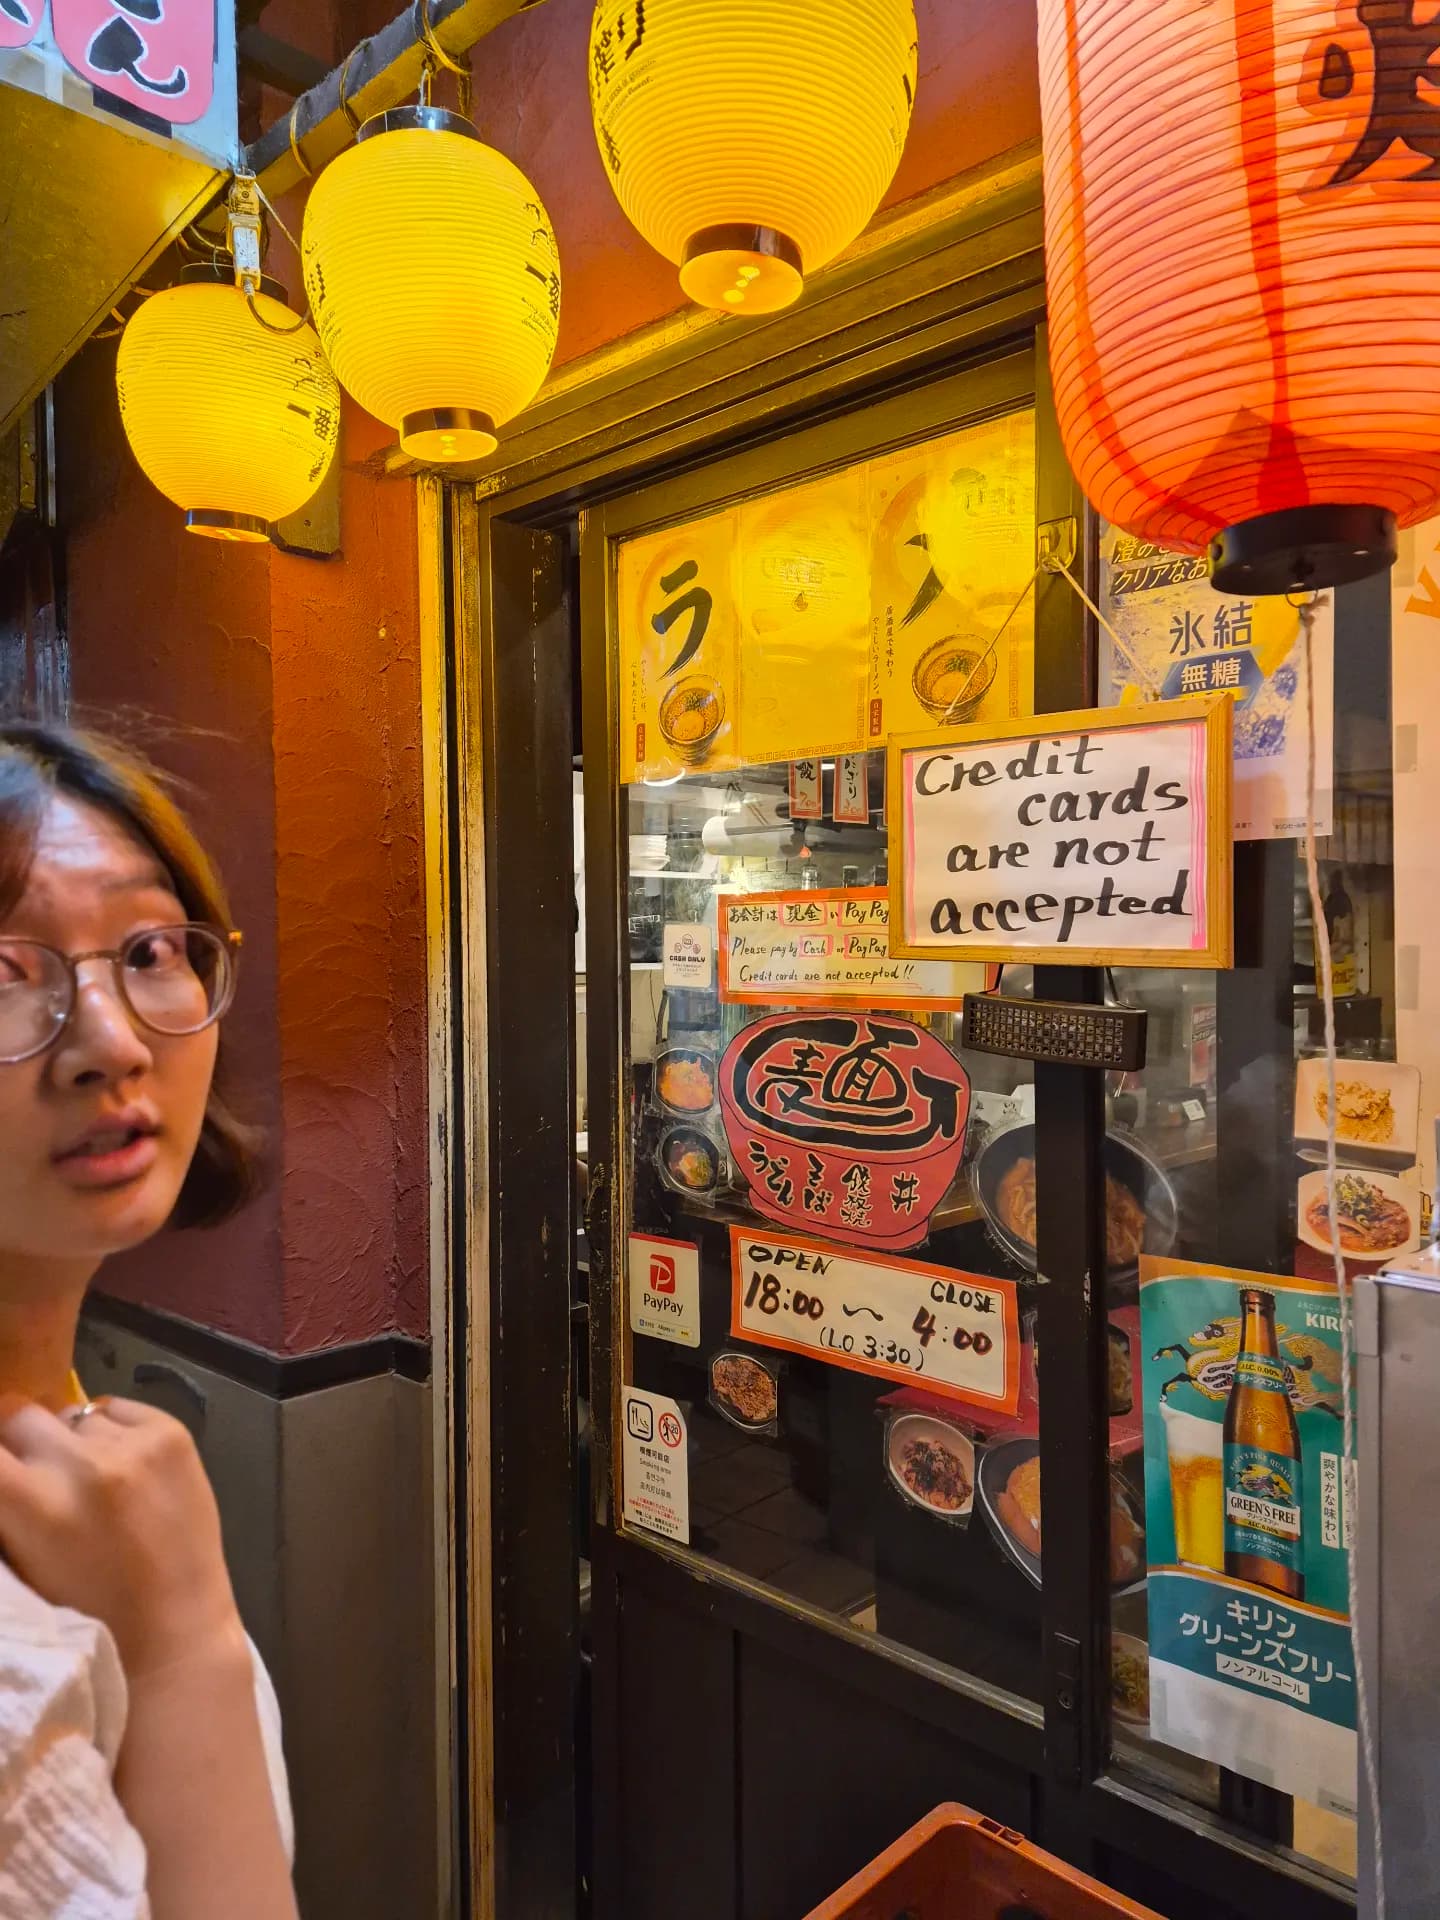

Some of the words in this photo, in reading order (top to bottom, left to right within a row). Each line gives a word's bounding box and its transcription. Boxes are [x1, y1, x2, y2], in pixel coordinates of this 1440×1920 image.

[1114, 556, 1207, 594] クリアなお
[650, 559, 713, 681] ラ
[1169, 601, 1253, 656] 氷結
[1181, 657, 1241, 692] 無糖
[915, 735, 1103, 796] Credit
[1017, 765, 1189, 826] cards
[946, 841, 1029, 872] are
[1053, 820, 1165, 868] not
[930, 869, 1192, 942] accepted
[732, 937, 767, 956] Please
[770, 945, 788, 957] pay
[803, 940, 826, 954] Cash
[739, 965, 772, 982] Credit
[775, 970, 798, 981] cards
[804, 972, 821, 981] are
[825, 970, 841, 981] not
[748, 1140, 795, 1206] うどん
[803, 1152, 833, 1214] そば
[891, 1172, 920, 1215] 丼
[643, 1293, 684, 1316] PayPay
[748, 1245, 834, 1275] OPEN
[930, 1280, 997, 1313] CLOSE
[744, 1272, 824, 1320] 18:00
[912, 1306, 993, 1355] 4:00
[1231, 1496, 1270, 1517] GREEN'S
[1272, 1508, 1296, 1525] FREE
[1323, 1458, 1337, 1542] 爽やかな味わい
[1226, 1600, 1296, 1638] キリン
[1179, 1612, 1352, 1683] グリーンズフリー
[1222, 1660, 1304, 1697] ノンアルコール
